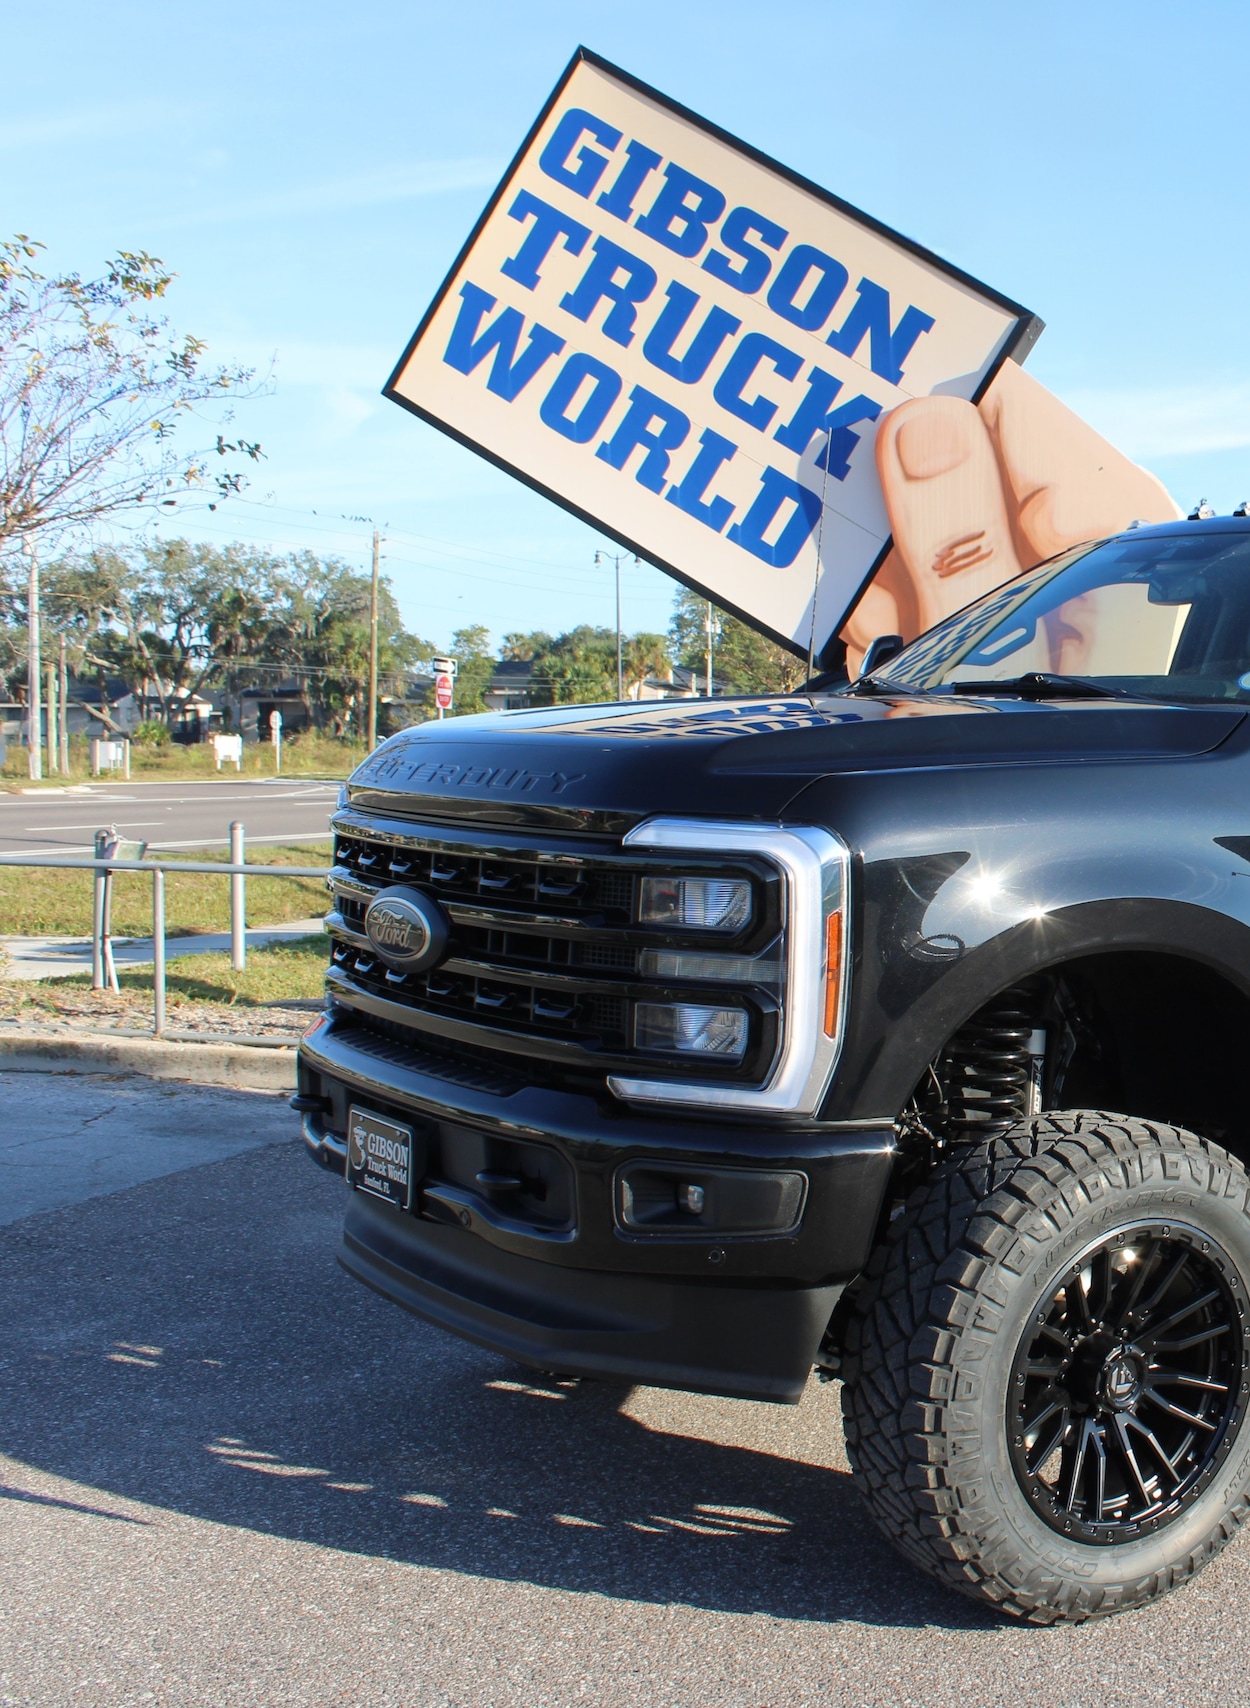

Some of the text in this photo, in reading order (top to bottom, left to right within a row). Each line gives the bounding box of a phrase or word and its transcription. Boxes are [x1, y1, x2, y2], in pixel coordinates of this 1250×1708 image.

[538, 107, 936, 384] GIBSON
[500, 189, 883, 482] TRUCK
[442, 280, 823, 569] WORLD
[457, 766, 587, 794] DUTY
[367, 1132, 409, 1168] GIBSON
[367, 1156, 407, 1185] Truck World
